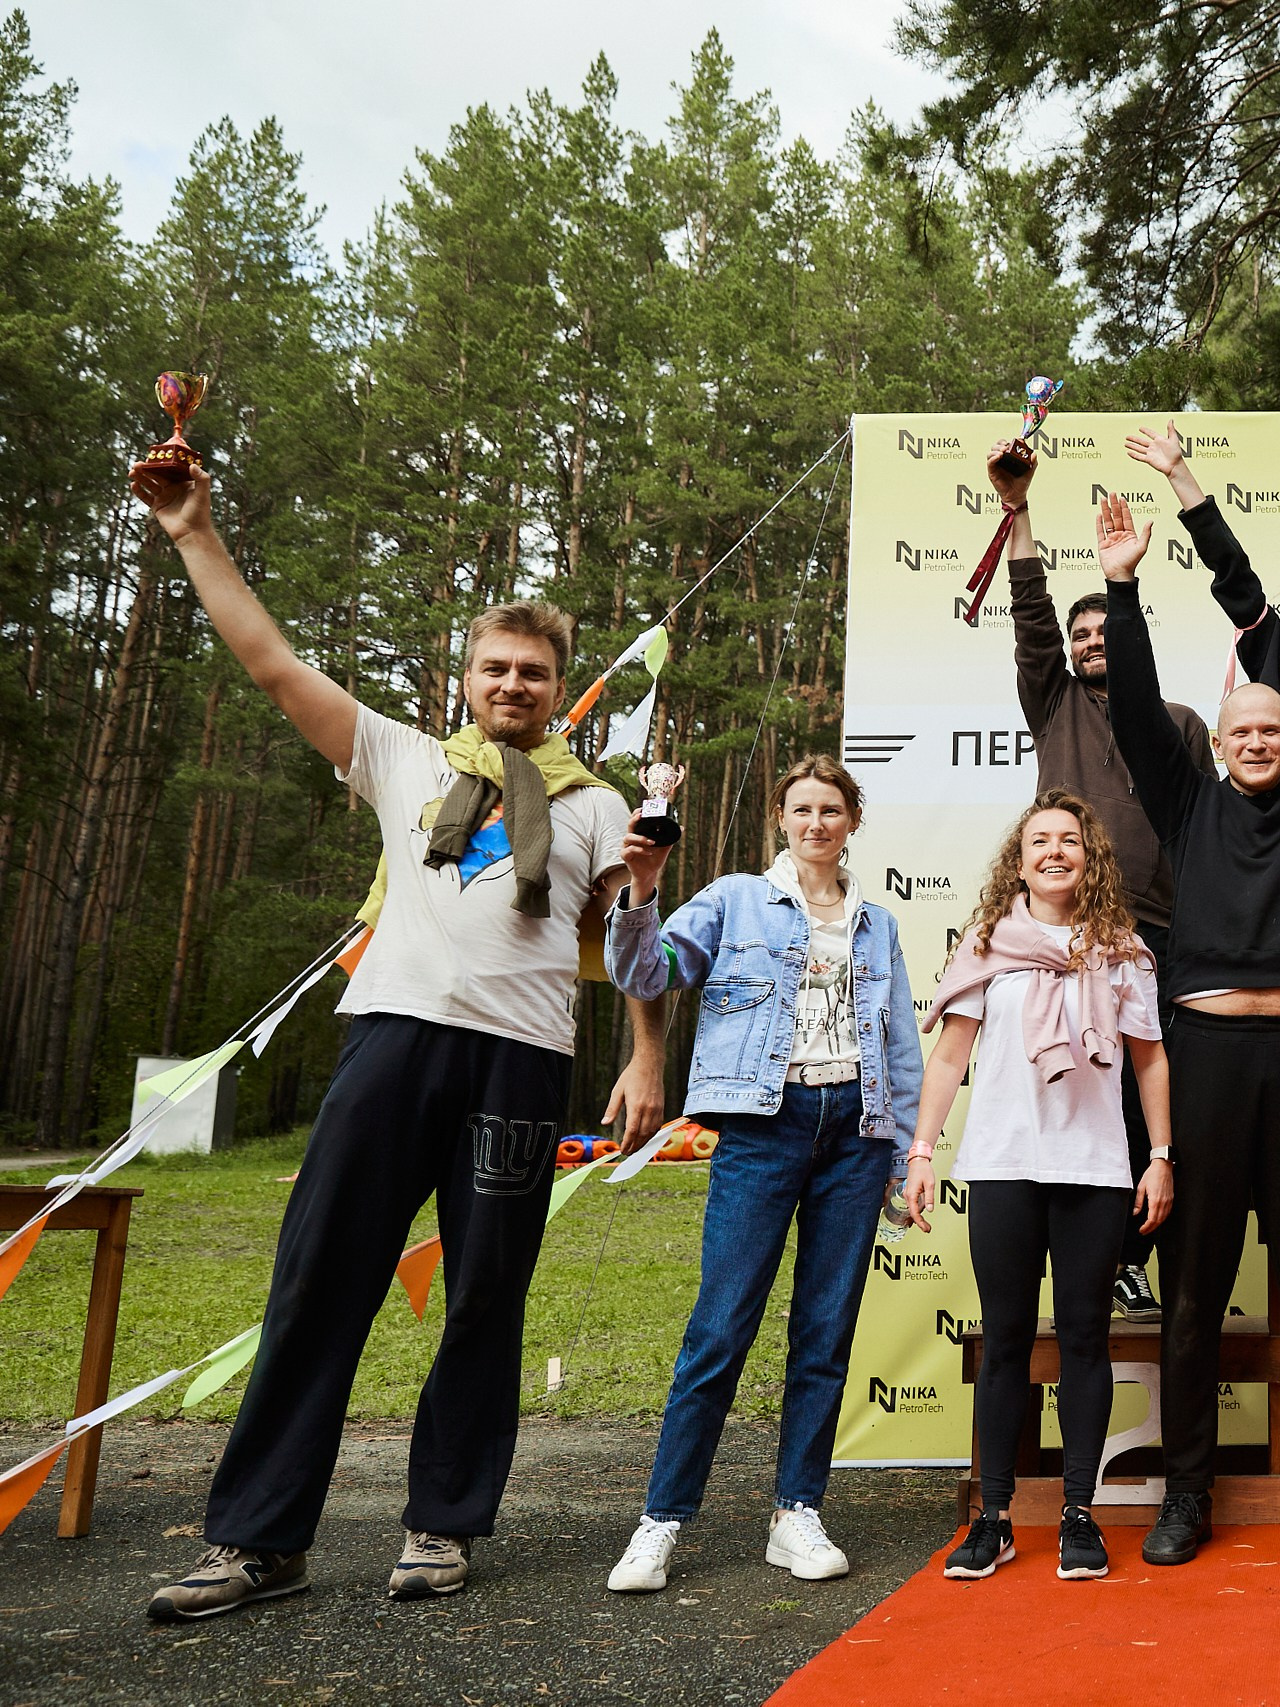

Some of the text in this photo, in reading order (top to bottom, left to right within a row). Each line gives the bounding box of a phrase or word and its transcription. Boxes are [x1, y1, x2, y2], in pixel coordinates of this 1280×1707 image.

[927, 437, 961, 448] NIKA
[1061, 437, 1095, 448] NIKA
[1196, 437, 1230, 447] NIKA
[926, 451, 967, 460] PetroTech
[1061, 451, 1102, 459] PetroTech
[1195, 450, 1236, 459] PetroTech
[985, 493, 1000, 503] NI
[1130, 506, 1161, 514] troTech
[924, 549, 959, 560] NIKA
[1060, 548, 1095, 559] NIKA
[924, 563, 965, 571] PetroTech
[983, 606, 1011, 616] NIK
[983, 620, 1015, 628] PetroTe
[951, 730, 1036, 766] ПЕР
[915, 876, 951, 889] NIKA
[915, 892, 958, 901] PetroTech
[904, 1254, 942, 1267] NIKA
[904, 1270, 948, 1281] PetroTech
[900, 1386, 937, 1399] NIKA
[899, 1402, 944, 1414] PetroTech
